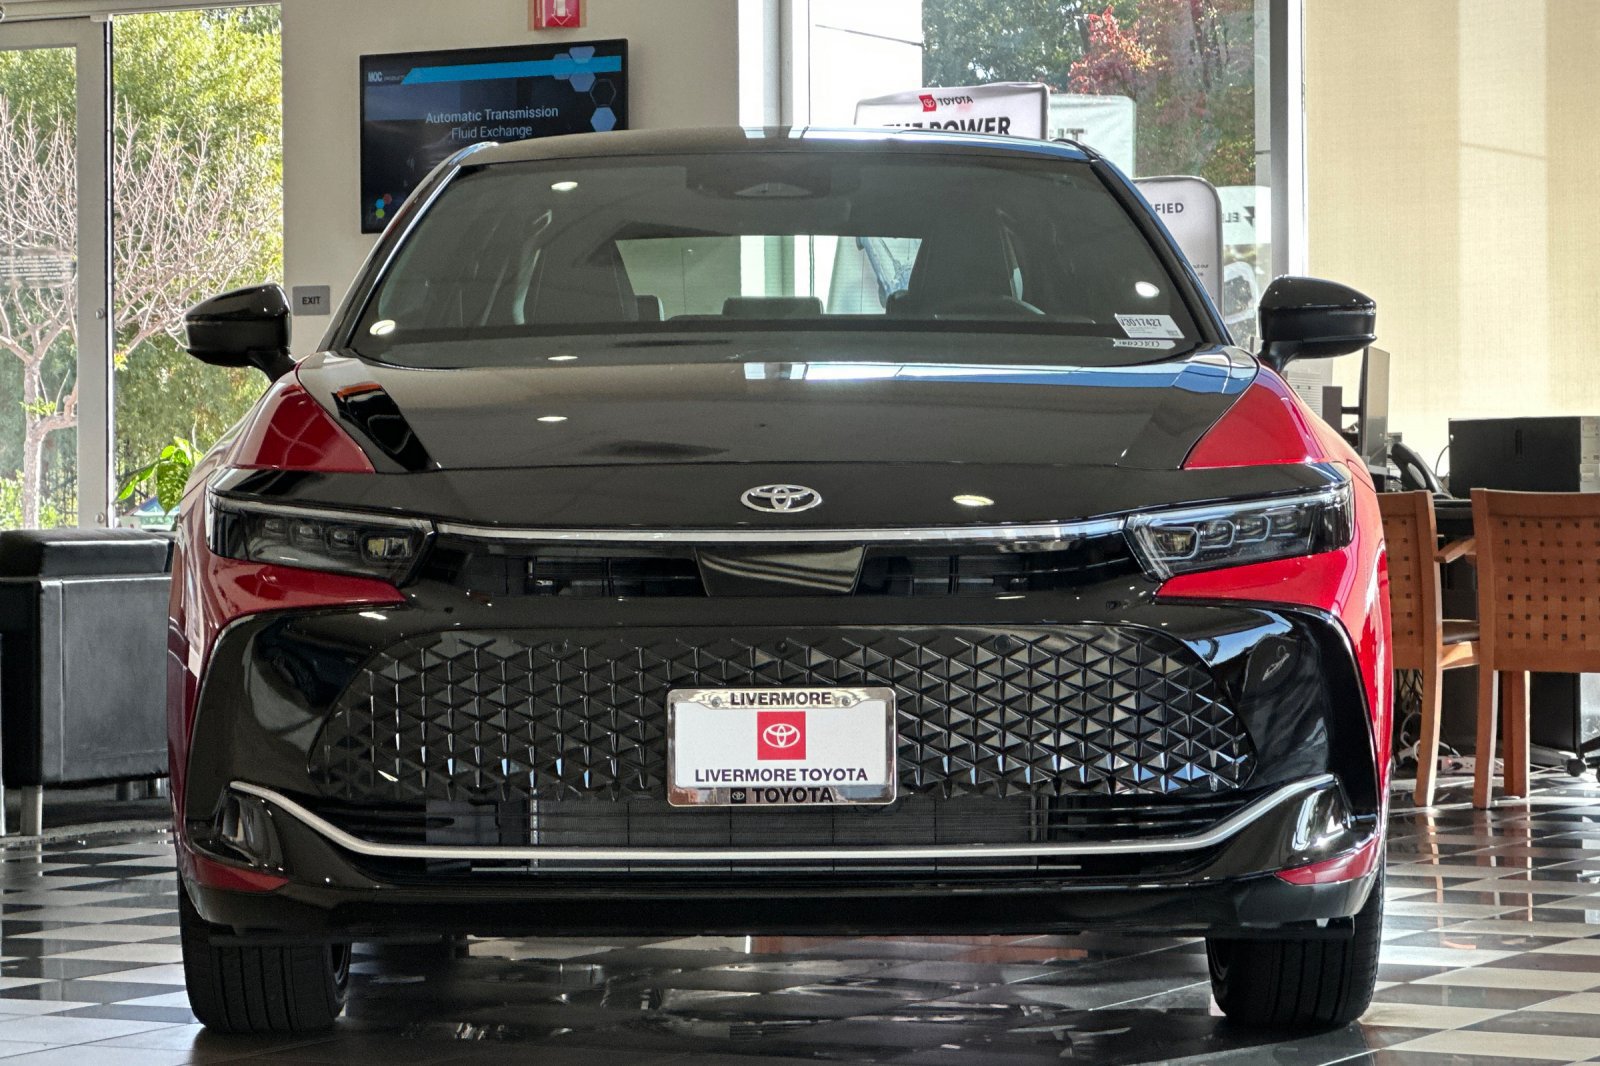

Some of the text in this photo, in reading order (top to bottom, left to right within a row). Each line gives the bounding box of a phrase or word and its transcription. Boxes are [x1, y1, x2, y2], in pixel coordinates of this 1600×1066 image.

[937, 95, 974, 106] TOYOTA
[425, 105, 559, 124] Automatic Transmission
[451, 125, 533, 140] Fluid Exchange
[1151, 202, 1184, 214] FIED
[302, 296, 321, 305] EXIT
[730, 691, 832, 706] LIVERMORE
[695, 768, 868, 782] LIVERMORE TOYOTA
[752, 787, 834, 803] TOYOTA
